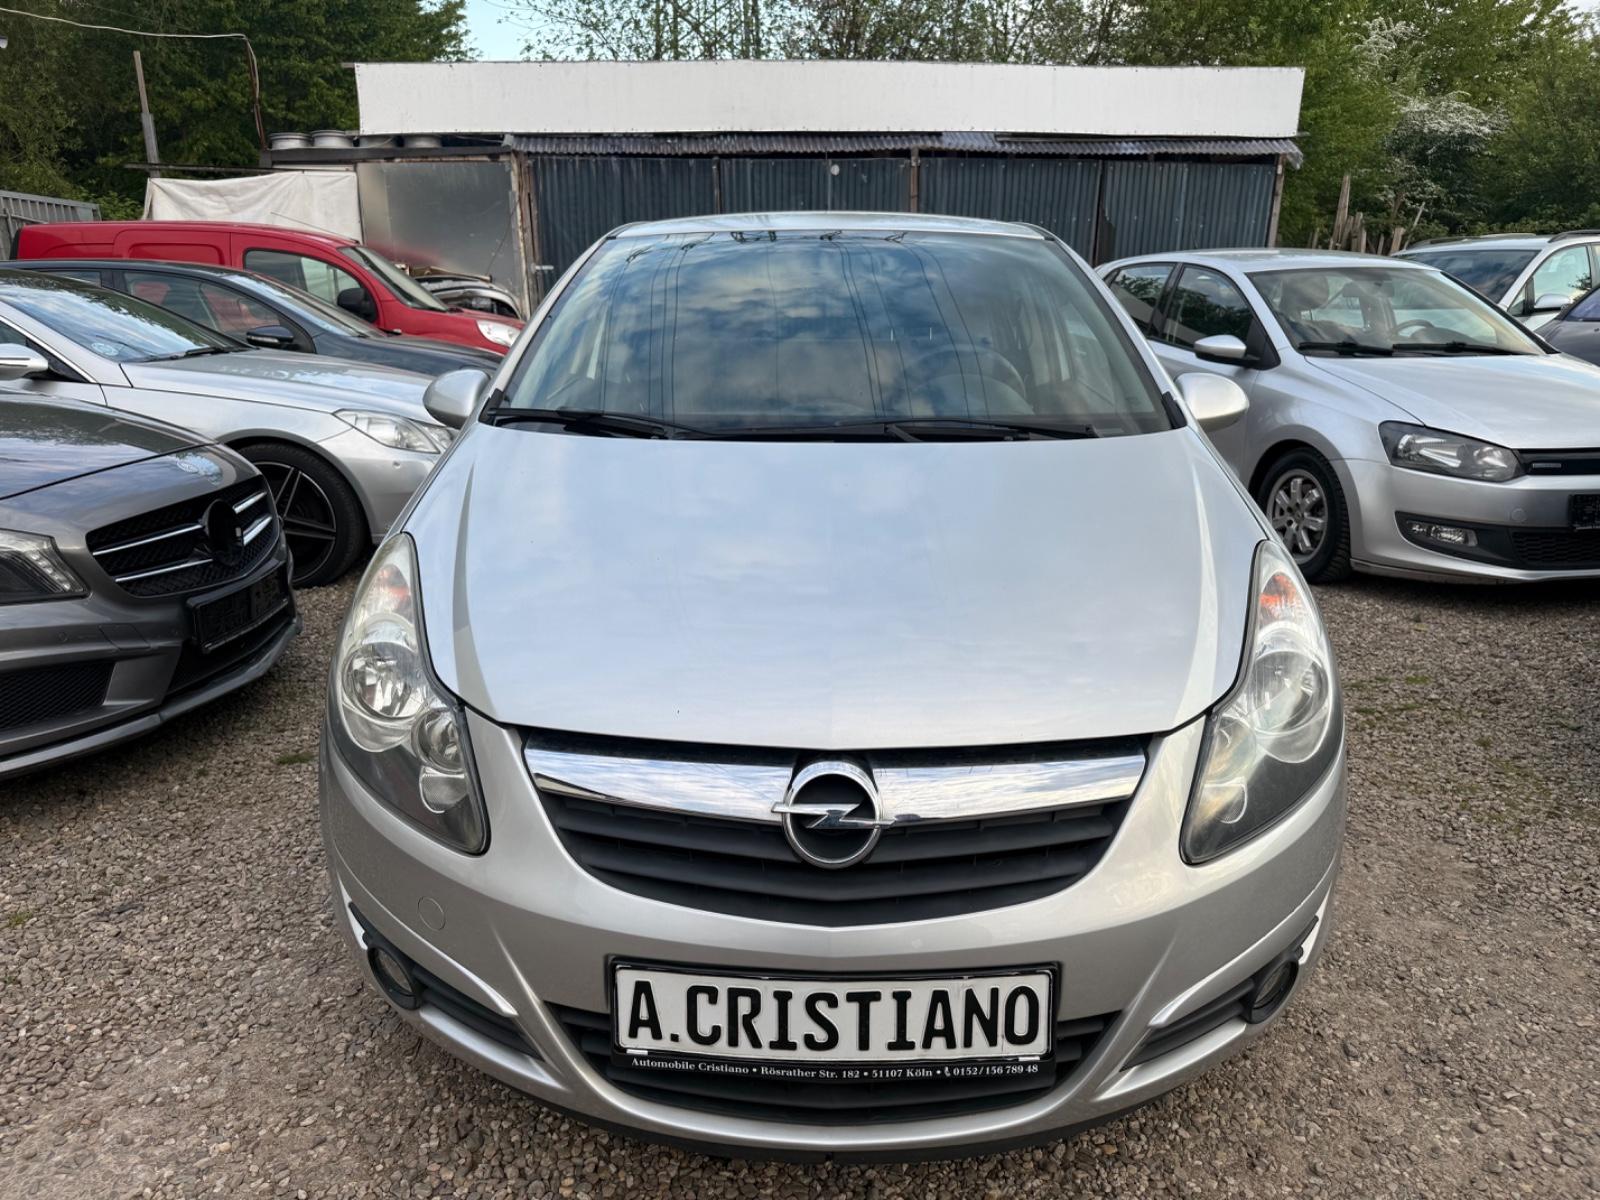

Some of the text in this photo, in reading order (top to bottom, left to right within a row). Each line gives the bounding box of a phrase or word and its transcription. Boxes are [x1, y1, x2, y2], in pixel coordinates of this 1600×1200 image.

[628, 980, 1039, 1051] A.CRISTIANO
[632, 1058, 695, 1070] Automobile
[698, 1062, 749, 1073] Cristiano
[761, 1066, 816, 1077] Rösrather
[819, 1069, 838, 1078] Str.
[842, 1070, 860, 1078] 182
[872, 1069, 903, 1078] 51107
[906, 1068, 933, 1077] Köln
